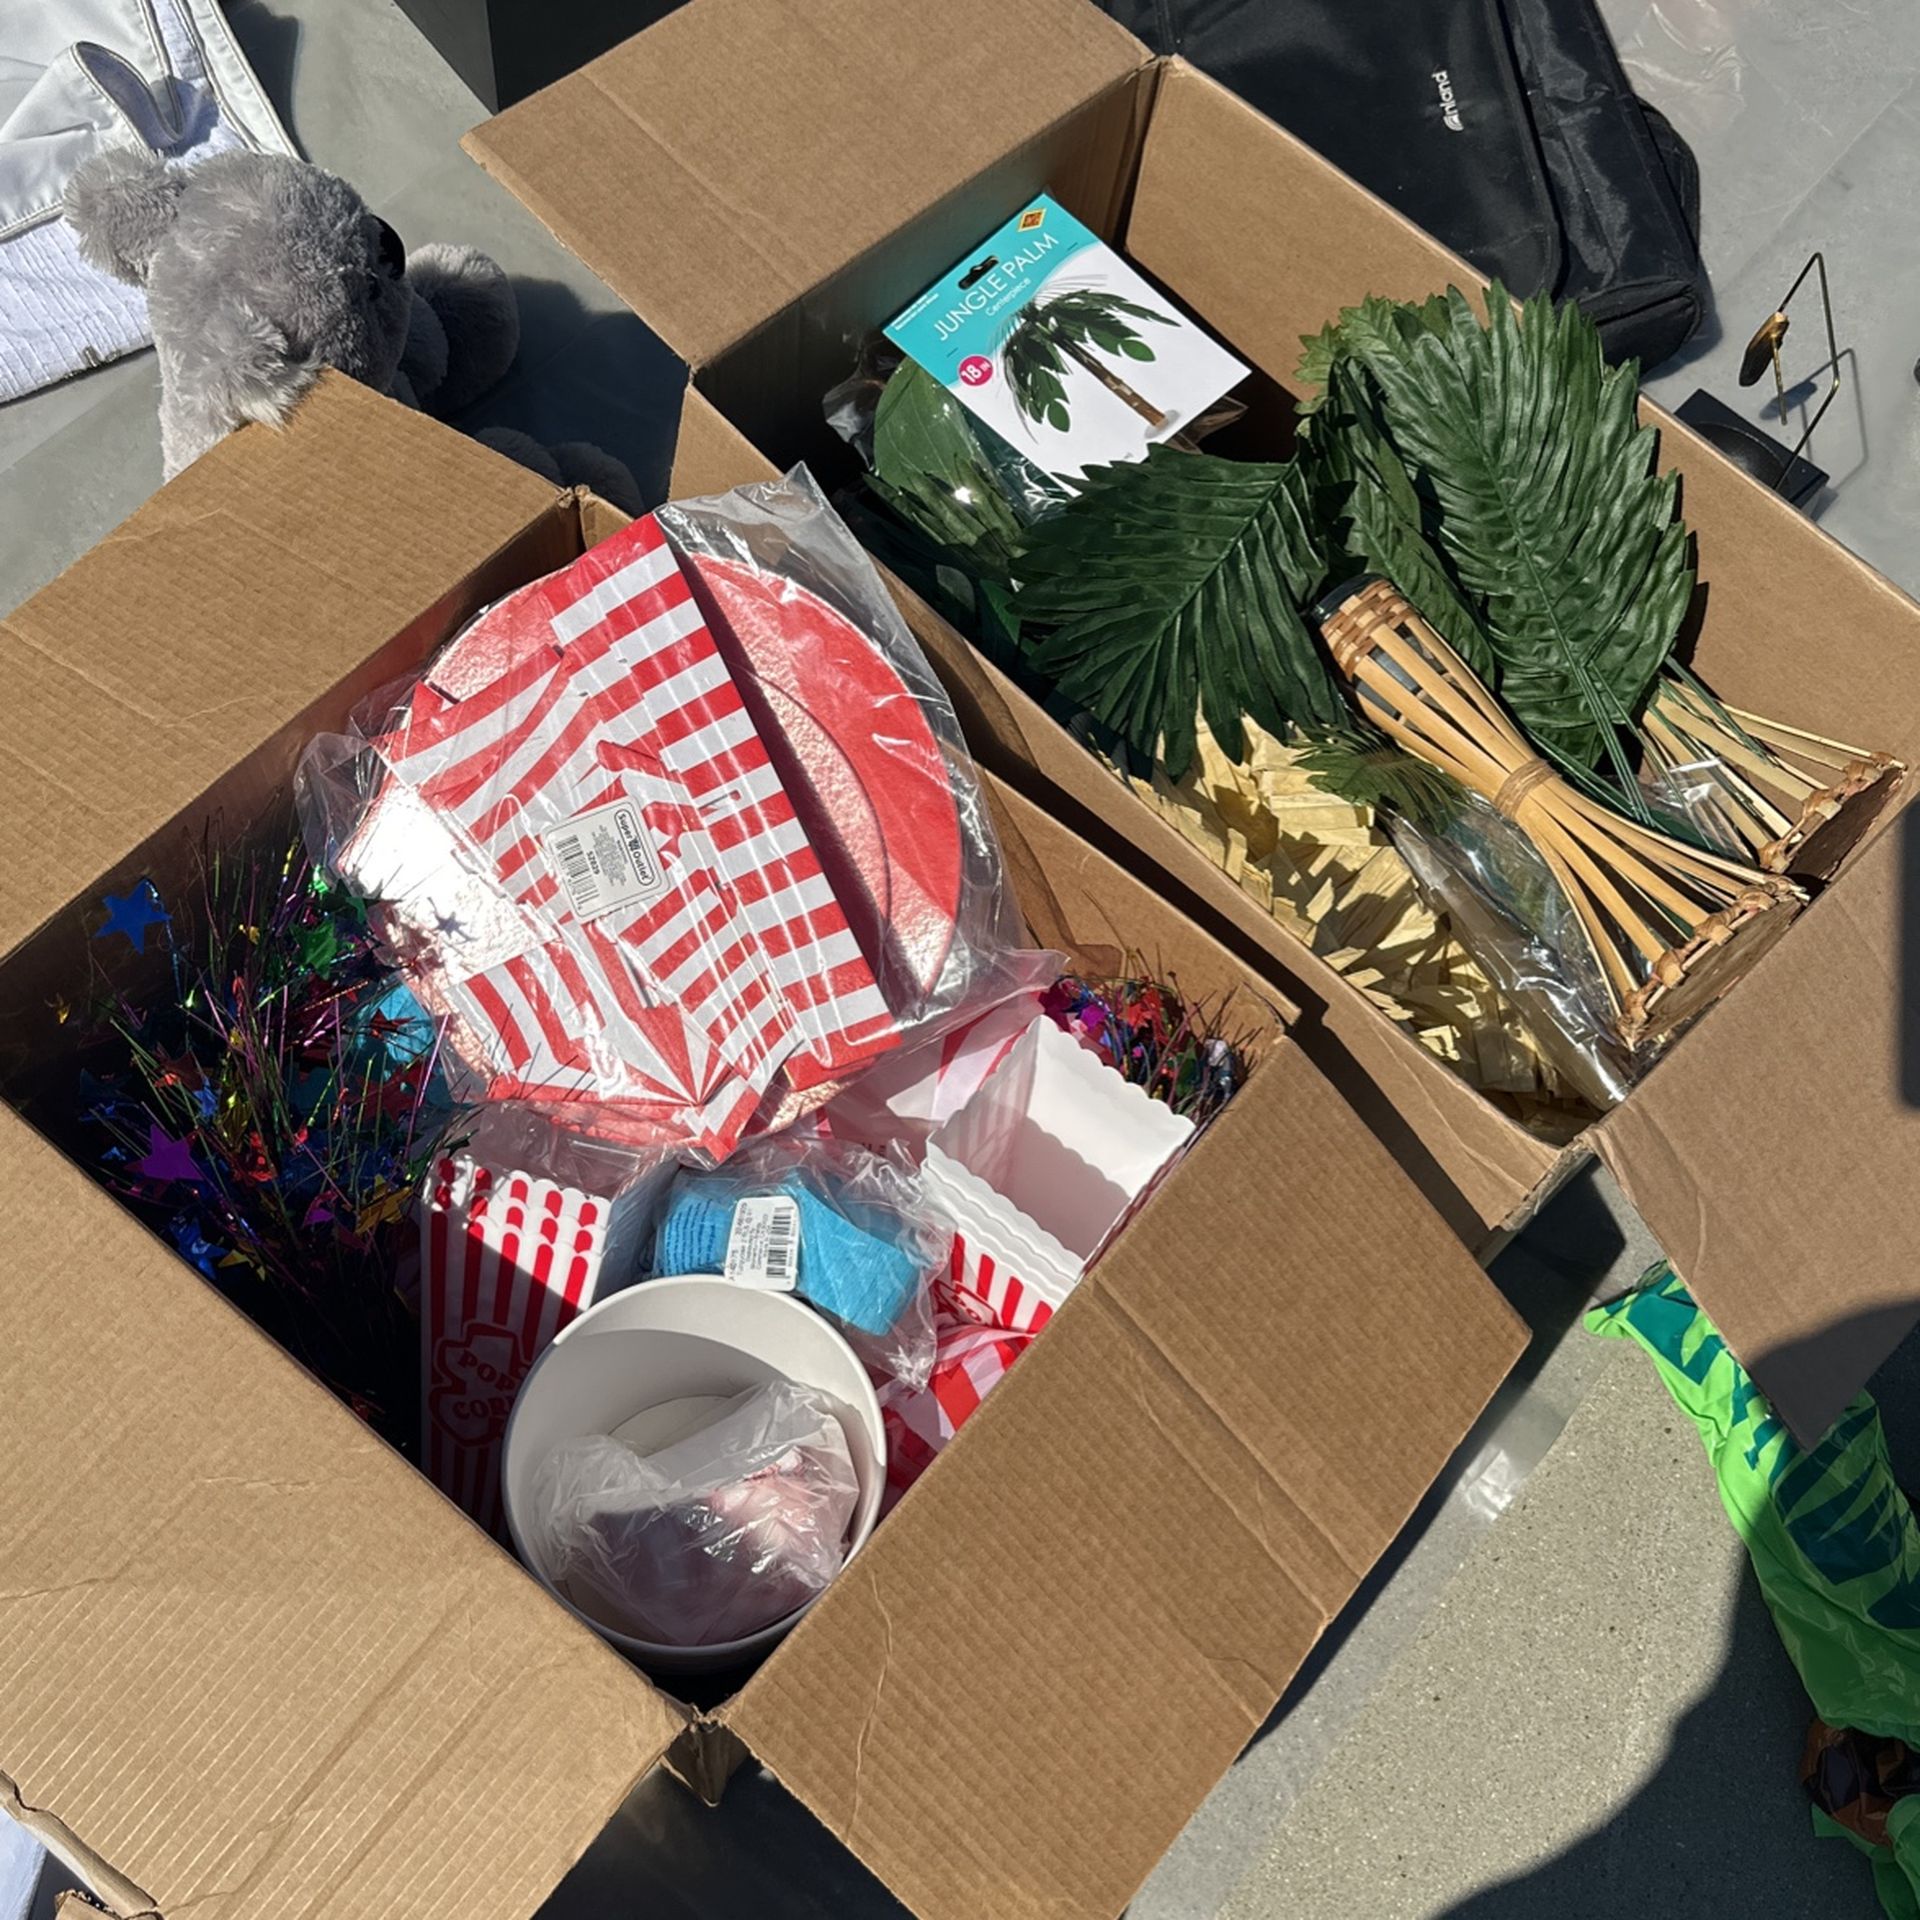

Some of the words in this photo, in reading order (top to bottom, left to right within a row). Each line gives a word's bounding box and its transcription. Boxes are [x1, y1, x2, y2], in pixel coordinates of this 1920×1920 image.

[933, 273, 1007, 342] JUNGLE
[1001, 232, 1059, 279] PALM
[985, 277, 1031, 317] Centerpiece
[959, 364, 982, 384] 18
[618, 813, 633, 840] Super
[633, 850, 652, 880] Outlet
[951, 1294, 983, 1323] PO
[457, 1348, 515, 1391] POP
